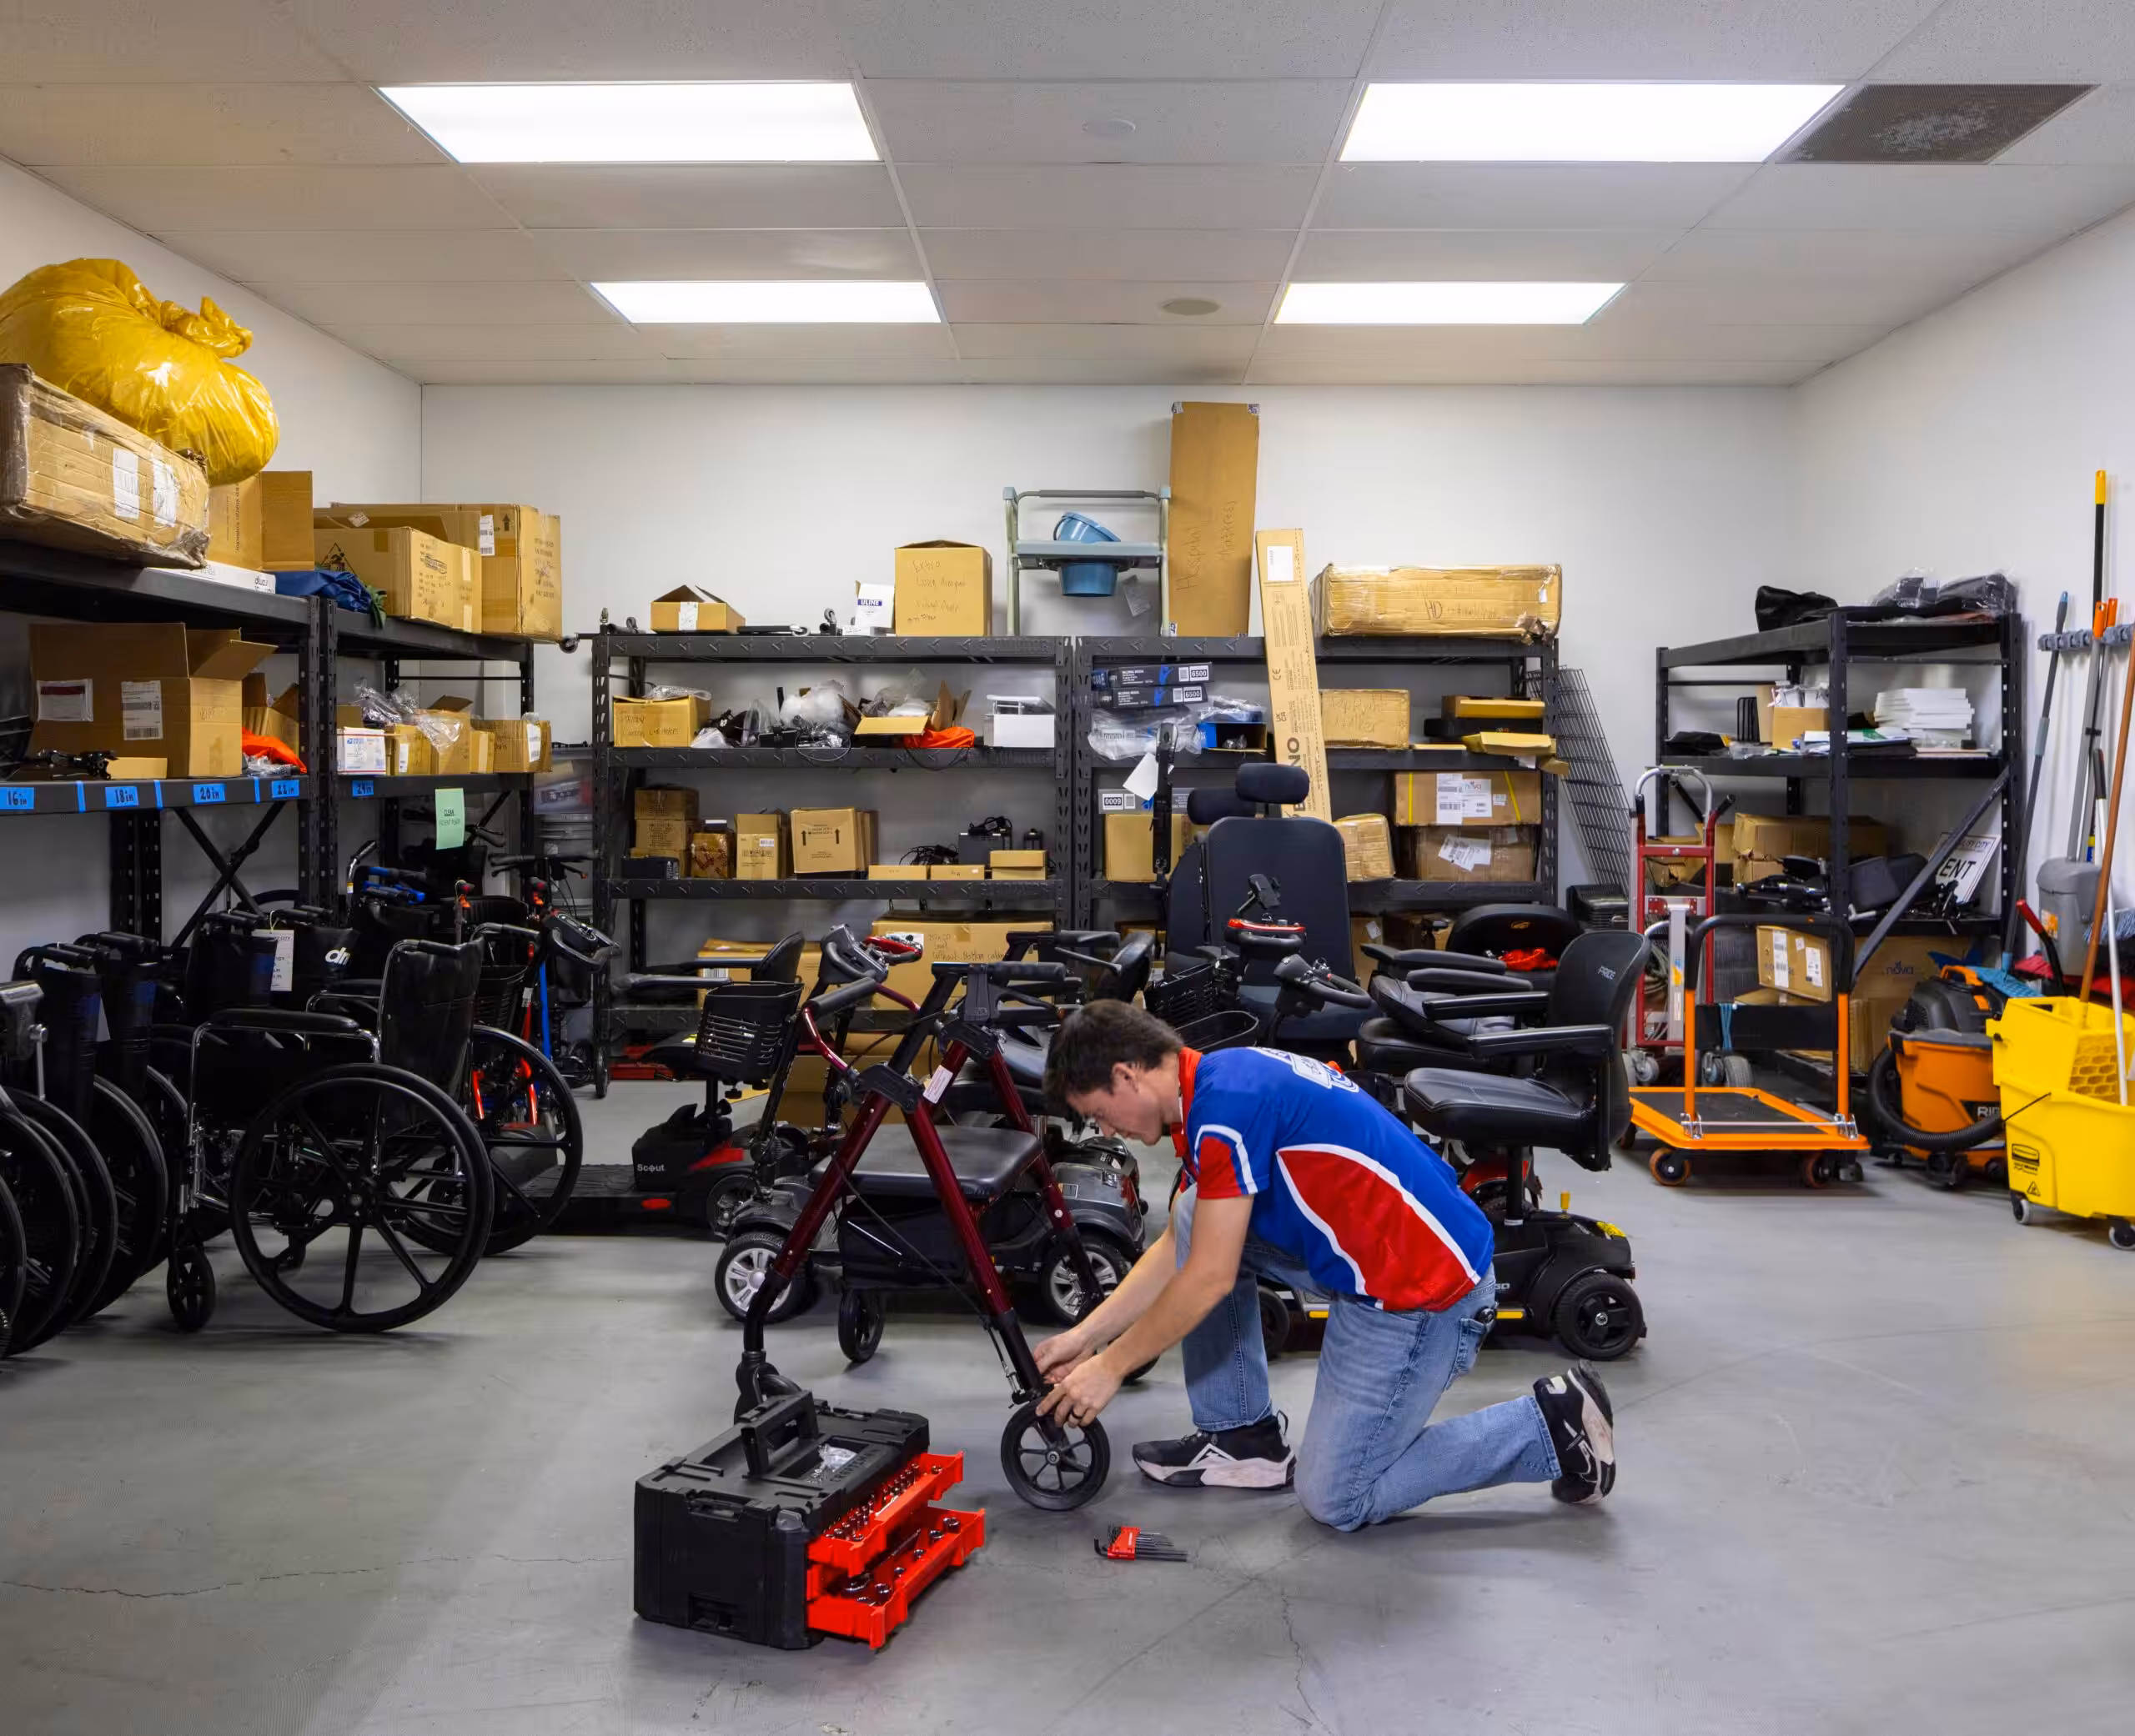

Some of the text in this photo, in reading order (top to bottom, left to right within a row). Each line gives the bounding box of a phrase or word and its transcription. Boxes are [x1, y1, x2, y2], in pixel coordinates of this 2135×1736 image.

[1191, 669, 1208, 678] 6500
[1185, 690, 1201, 699] 6500
[1939, 857, 1977, 880] ENT
[636, 1163, 666, 1172] Scout
